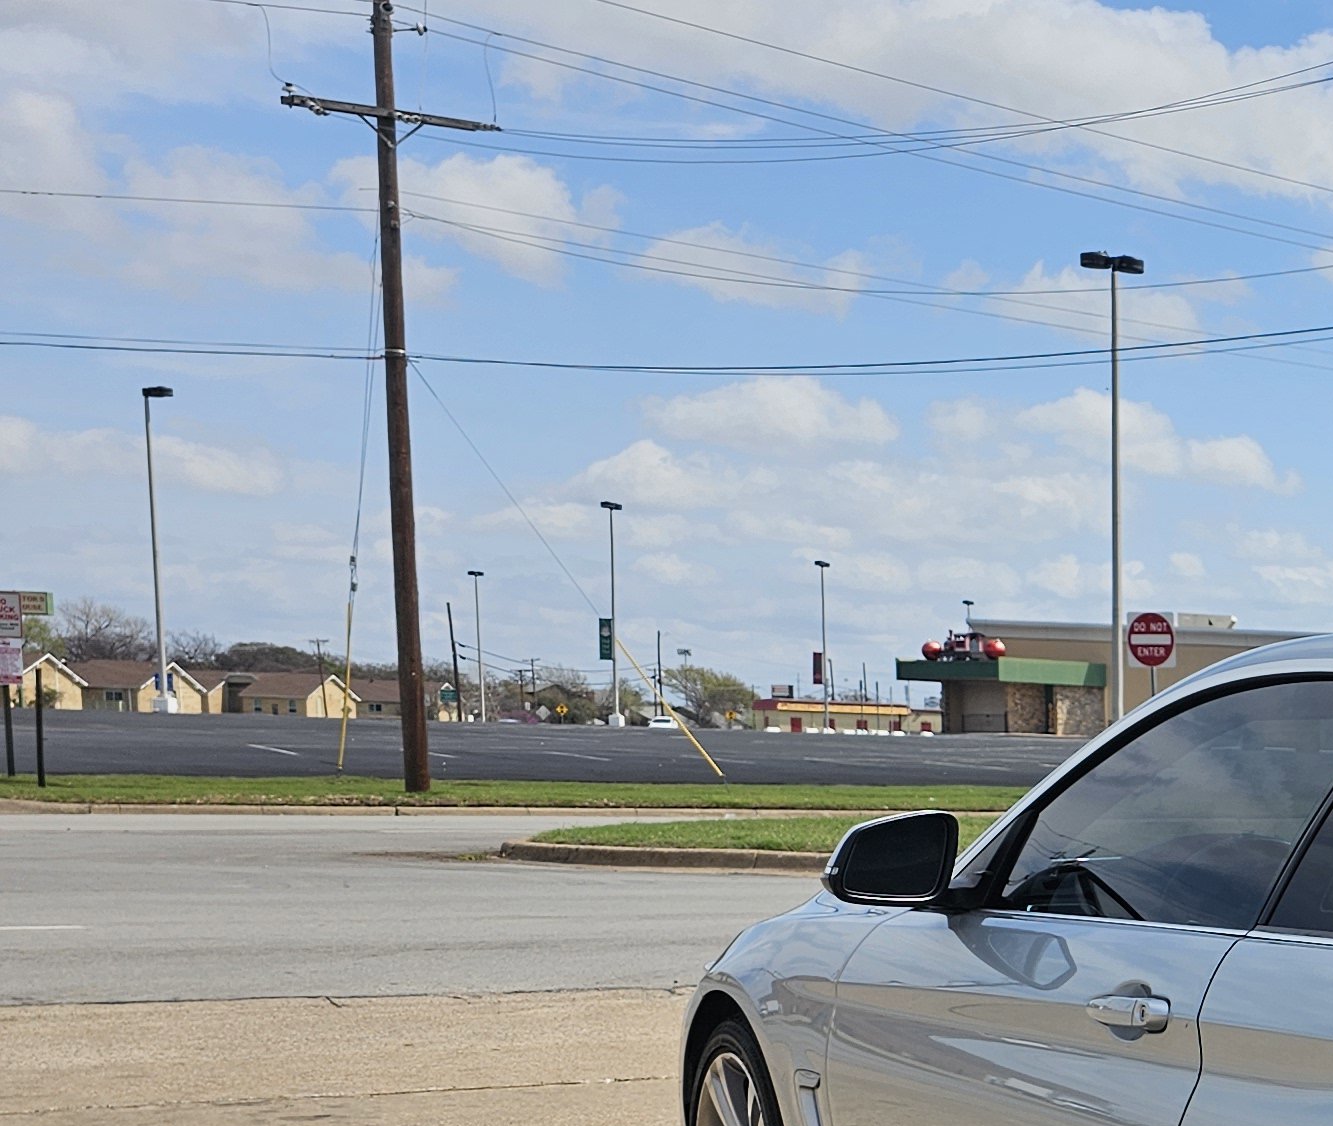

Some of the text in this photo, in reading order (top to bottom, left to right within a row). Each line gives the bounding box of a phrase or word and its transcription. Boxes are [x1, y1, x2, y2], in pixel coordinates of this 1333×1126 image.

[1133, 622, 1167, 632] DO NOT
[1137, 647, 1165, 657] ENTER
